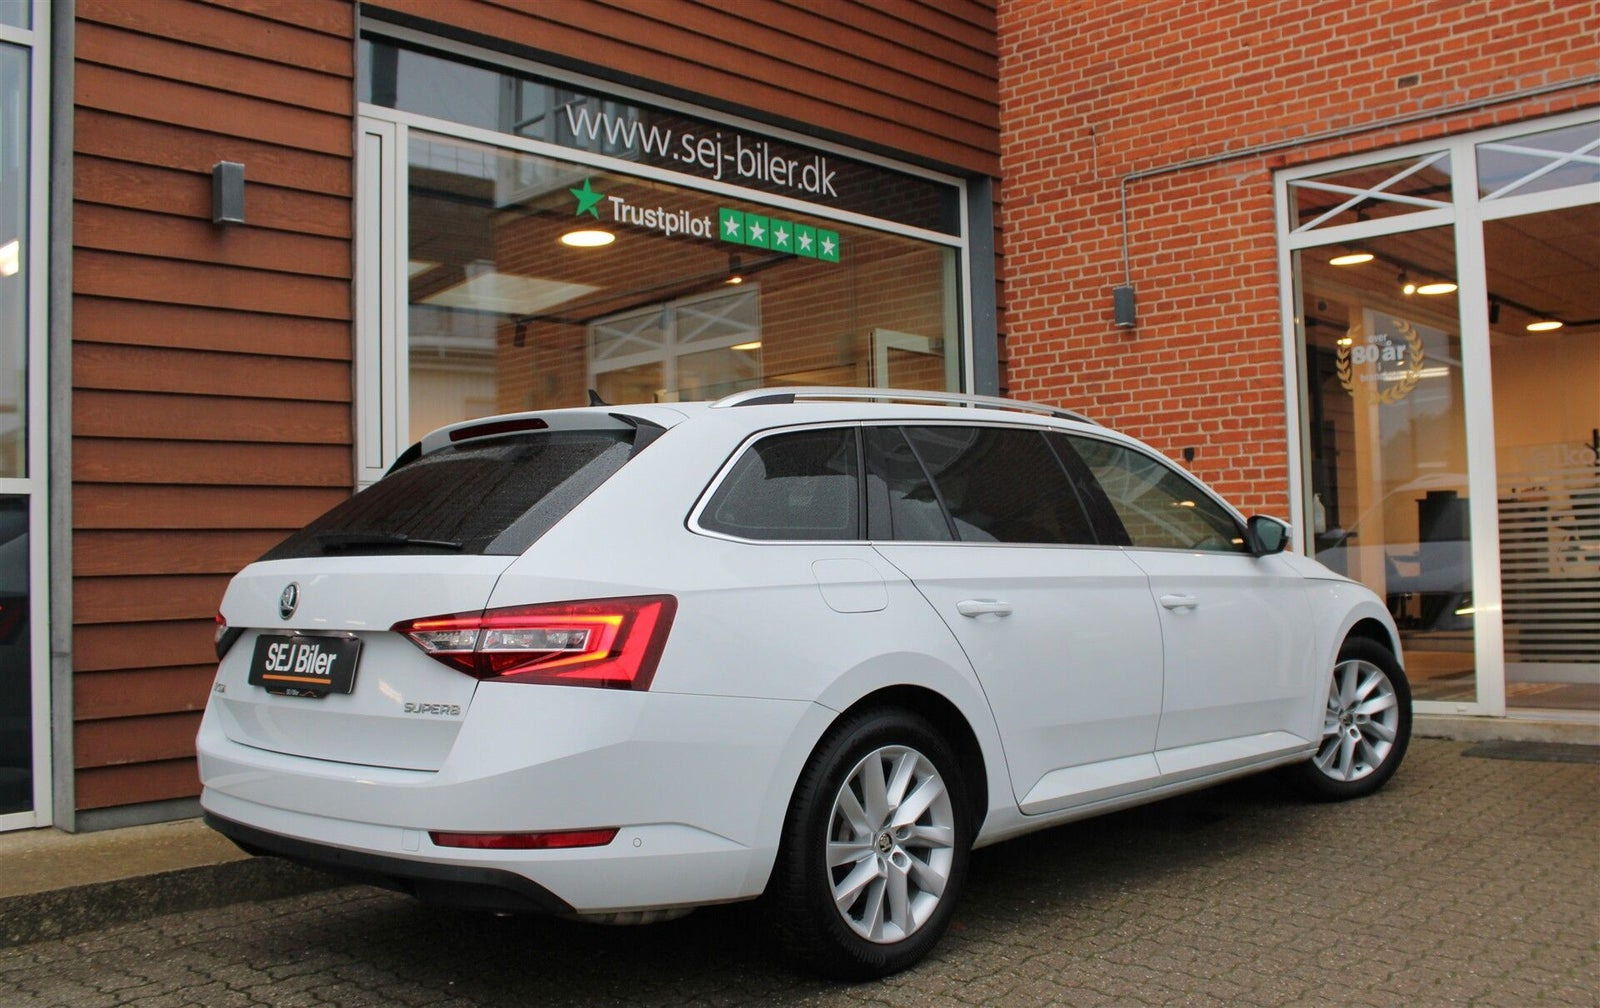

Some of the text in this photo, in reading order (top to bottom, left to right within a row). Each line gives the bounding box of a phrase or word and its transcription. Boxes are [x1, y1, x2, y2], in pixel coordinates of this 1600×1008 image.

[565, 103, 838, 198] www.sej-biler.dk
[608, 195, 712, 239] Trustpilot
[1351, 340, 1407, 364] 80 år
[265, 643, 337, 675] SEJ Biler
[404, 702, 461, 716] SUPERB
